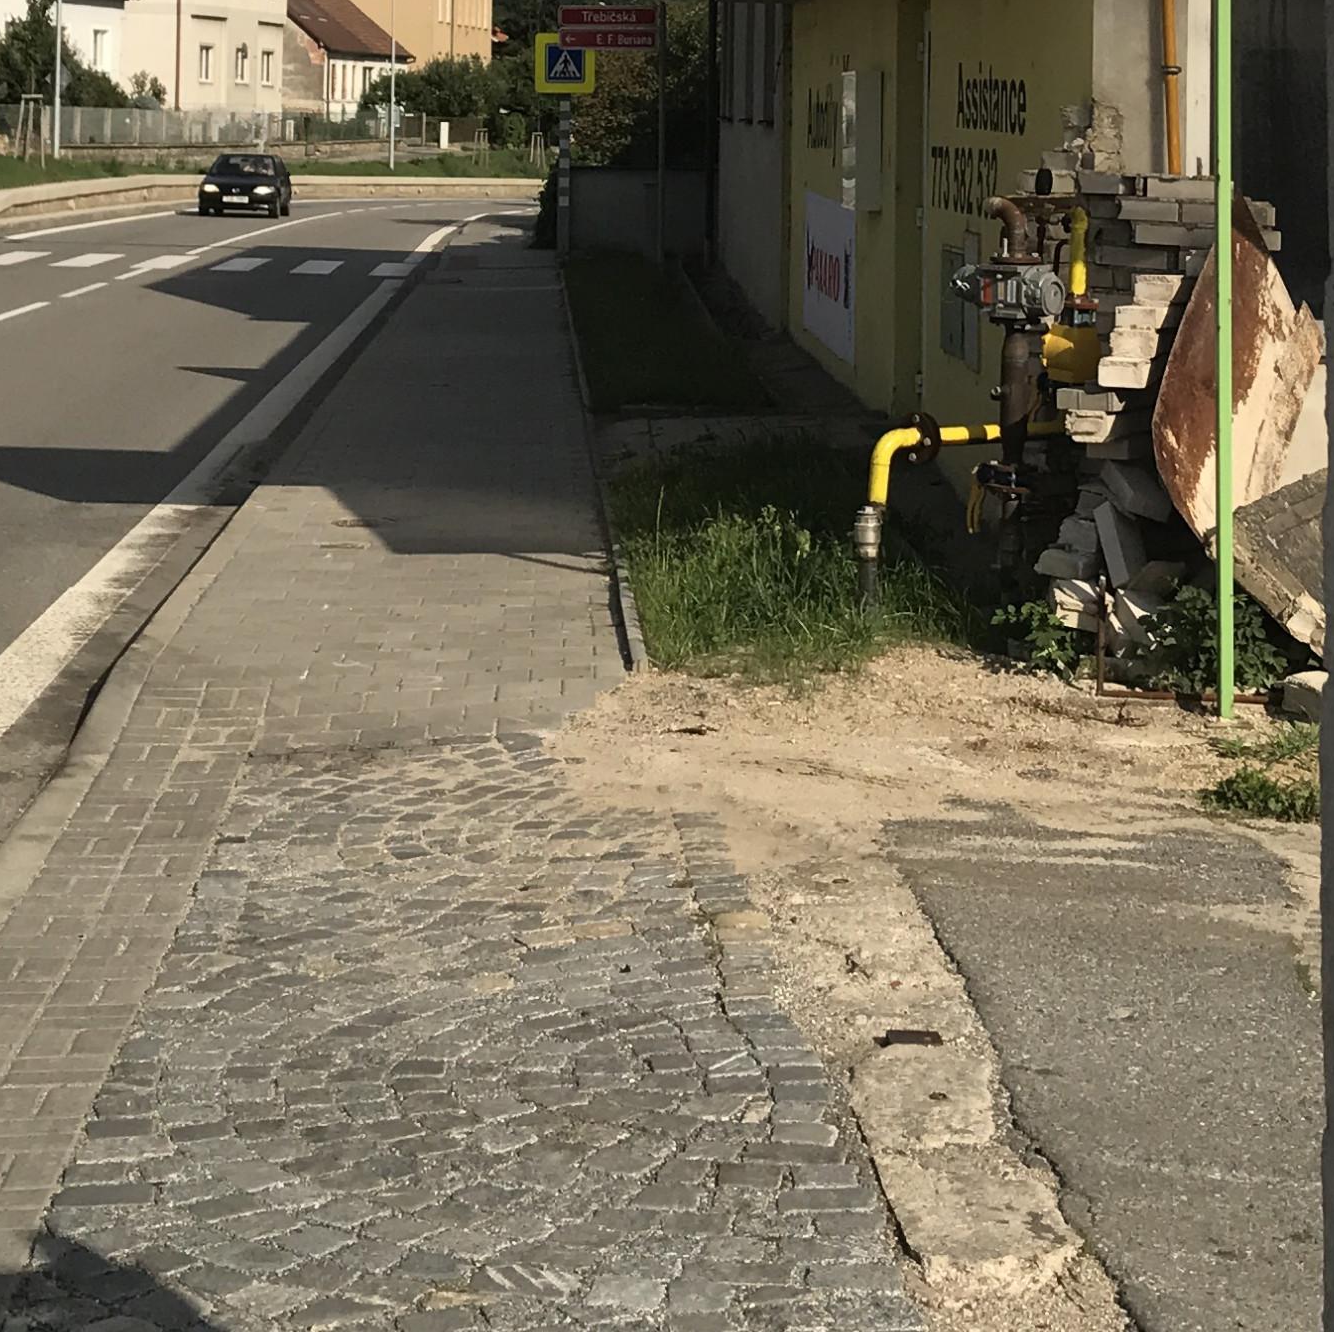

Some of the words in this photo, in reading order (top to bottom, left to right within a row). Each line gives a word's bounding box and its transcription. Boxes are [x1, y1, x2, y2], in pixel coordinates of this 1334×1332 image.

[956, 61, 1027, 136] Assistance
[931, 146, 950, 210] 773
[953, 147, 974, 215] 582
